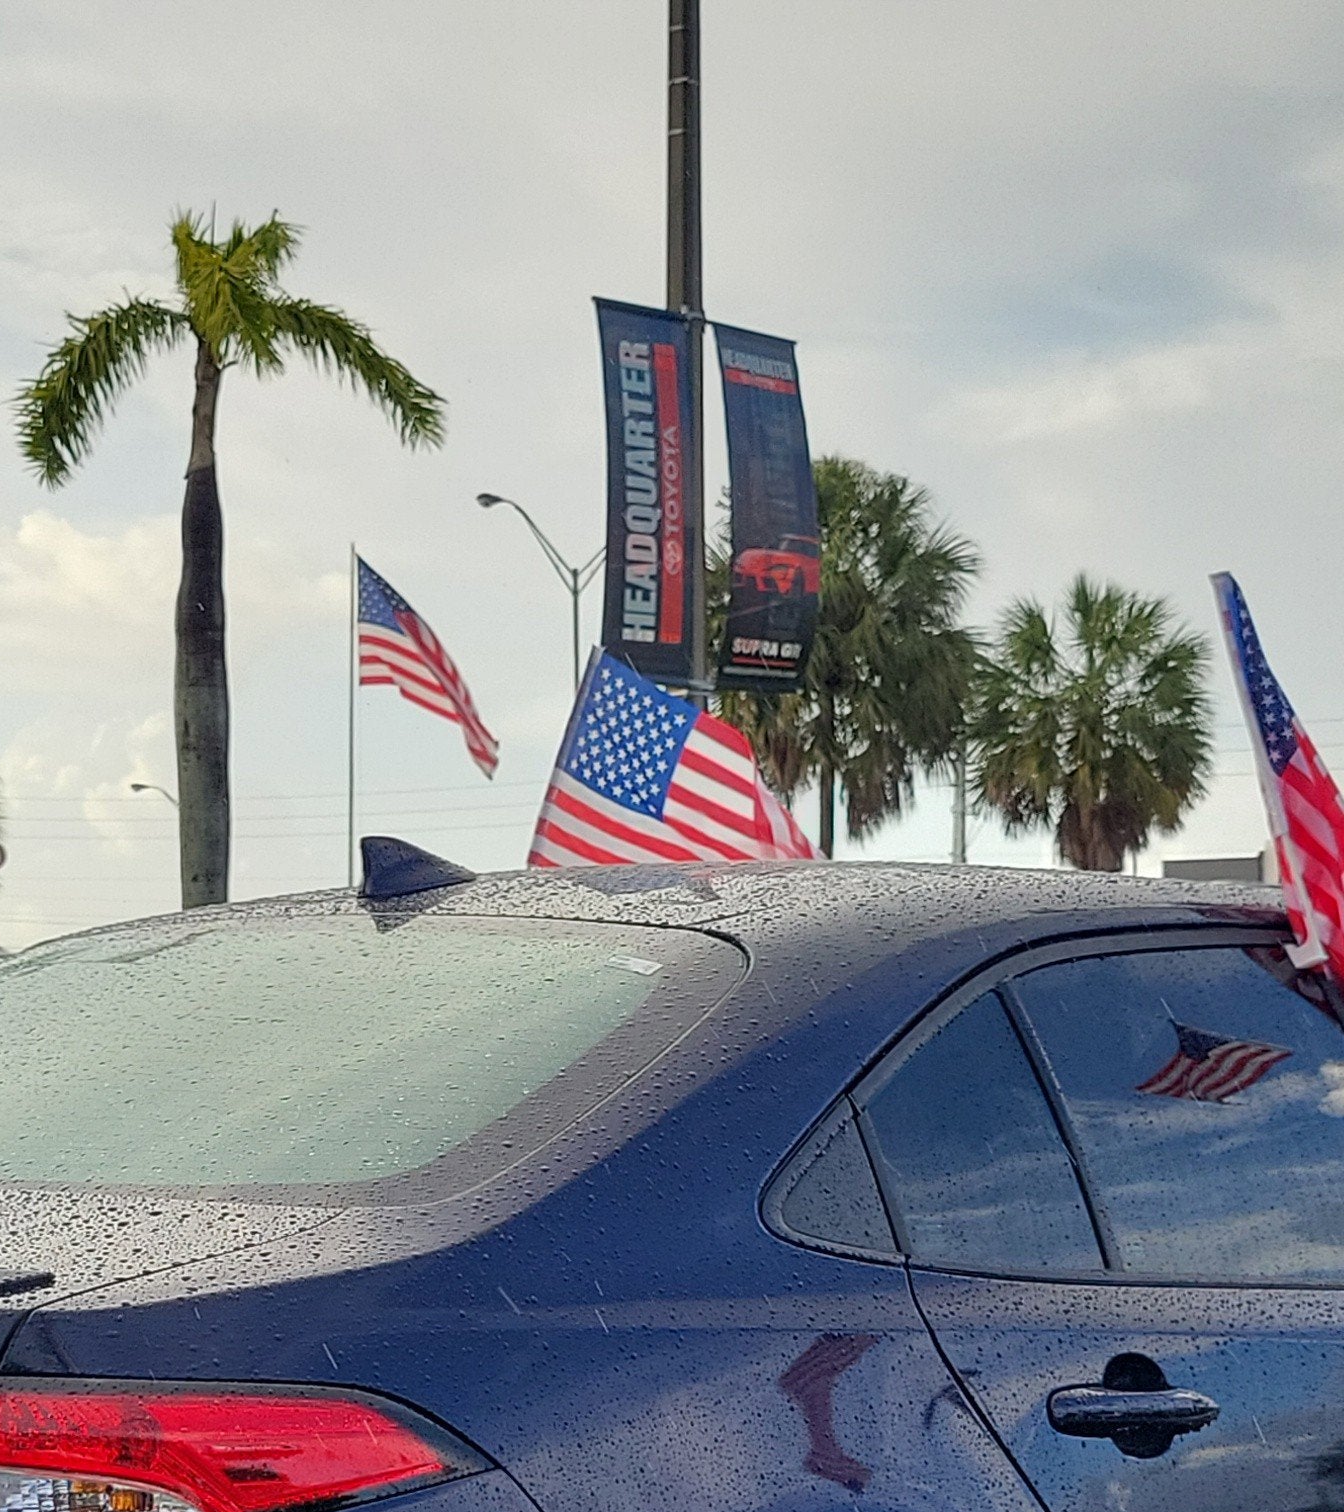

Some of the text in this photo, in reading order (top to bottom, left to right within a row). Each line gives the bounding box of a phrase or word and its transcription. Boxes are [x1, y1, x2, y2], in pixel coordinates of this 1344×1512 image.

[620, 340, 658, 643] HEADQUARTER
[660, 426, 681, 537] TOYOTA
[732, 637, 779, 657] SUPRA
